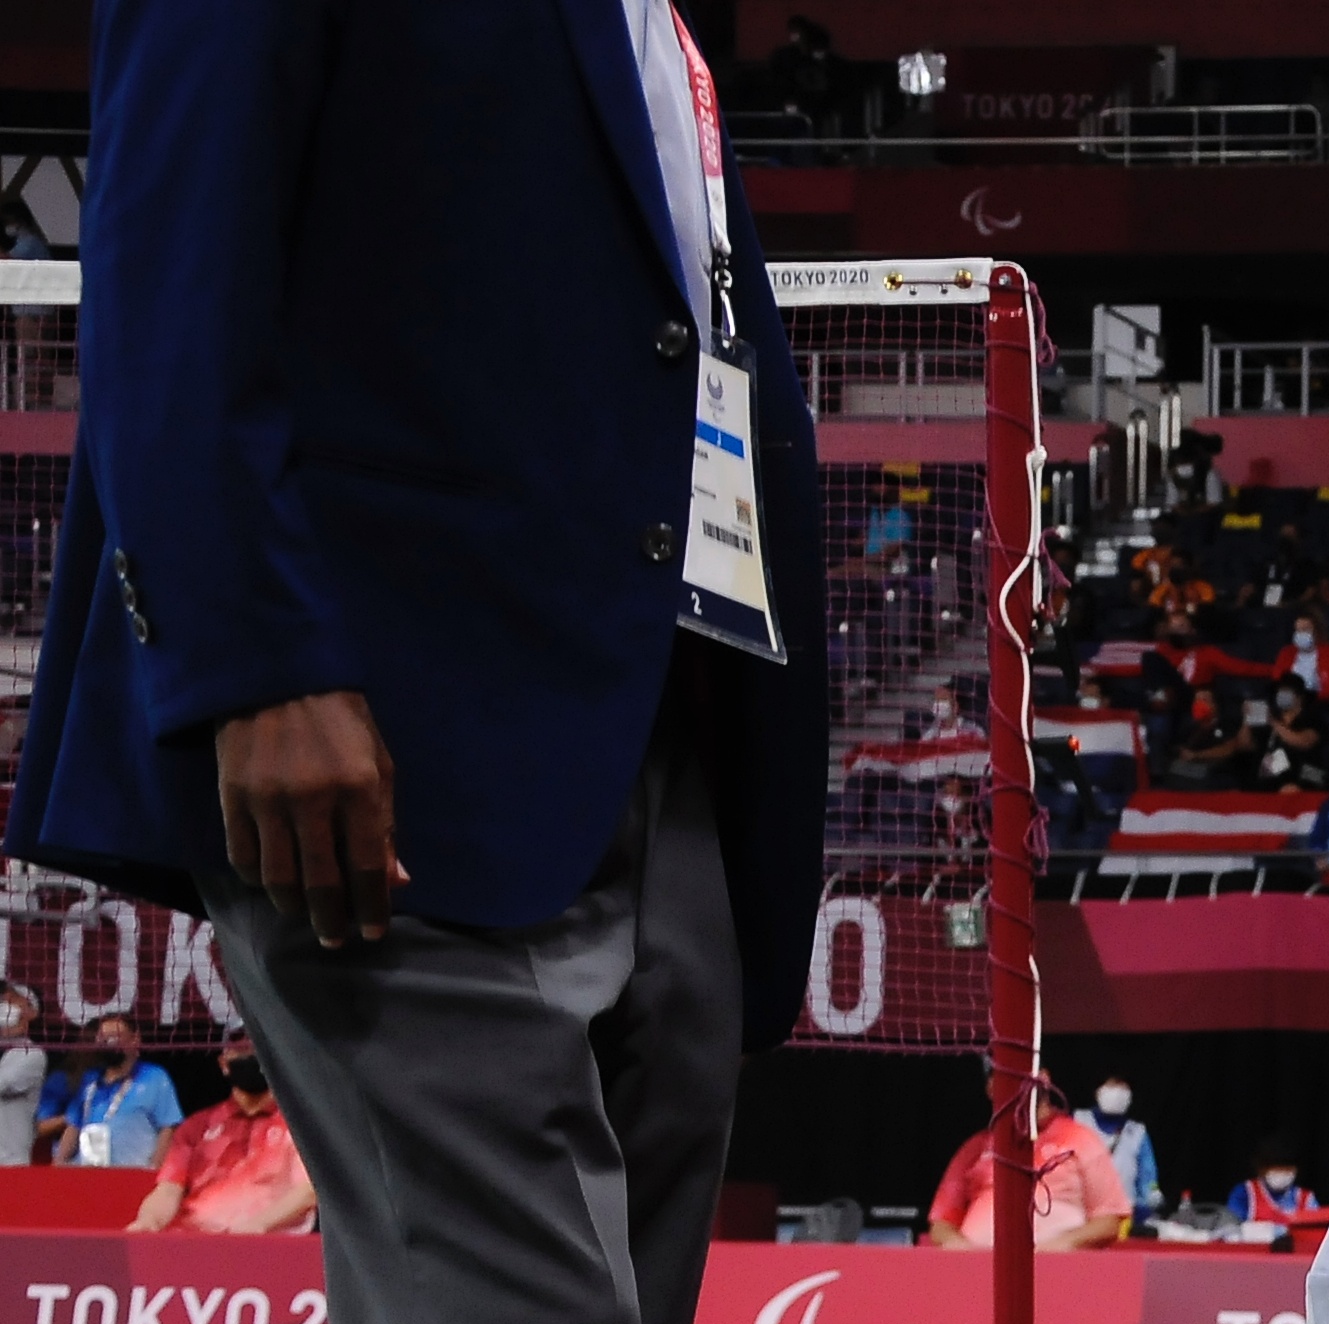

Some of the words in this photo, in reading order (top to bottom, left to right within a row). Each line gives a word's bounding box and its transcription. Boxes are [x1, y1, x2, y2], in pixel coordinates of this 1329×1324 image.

[962, 93, 1055, 120] TOKYO
[701, 106, 718, 169] 2020
[770, 272, 826, 287] TOKYO
[829, 268, 870, 284] 2020
